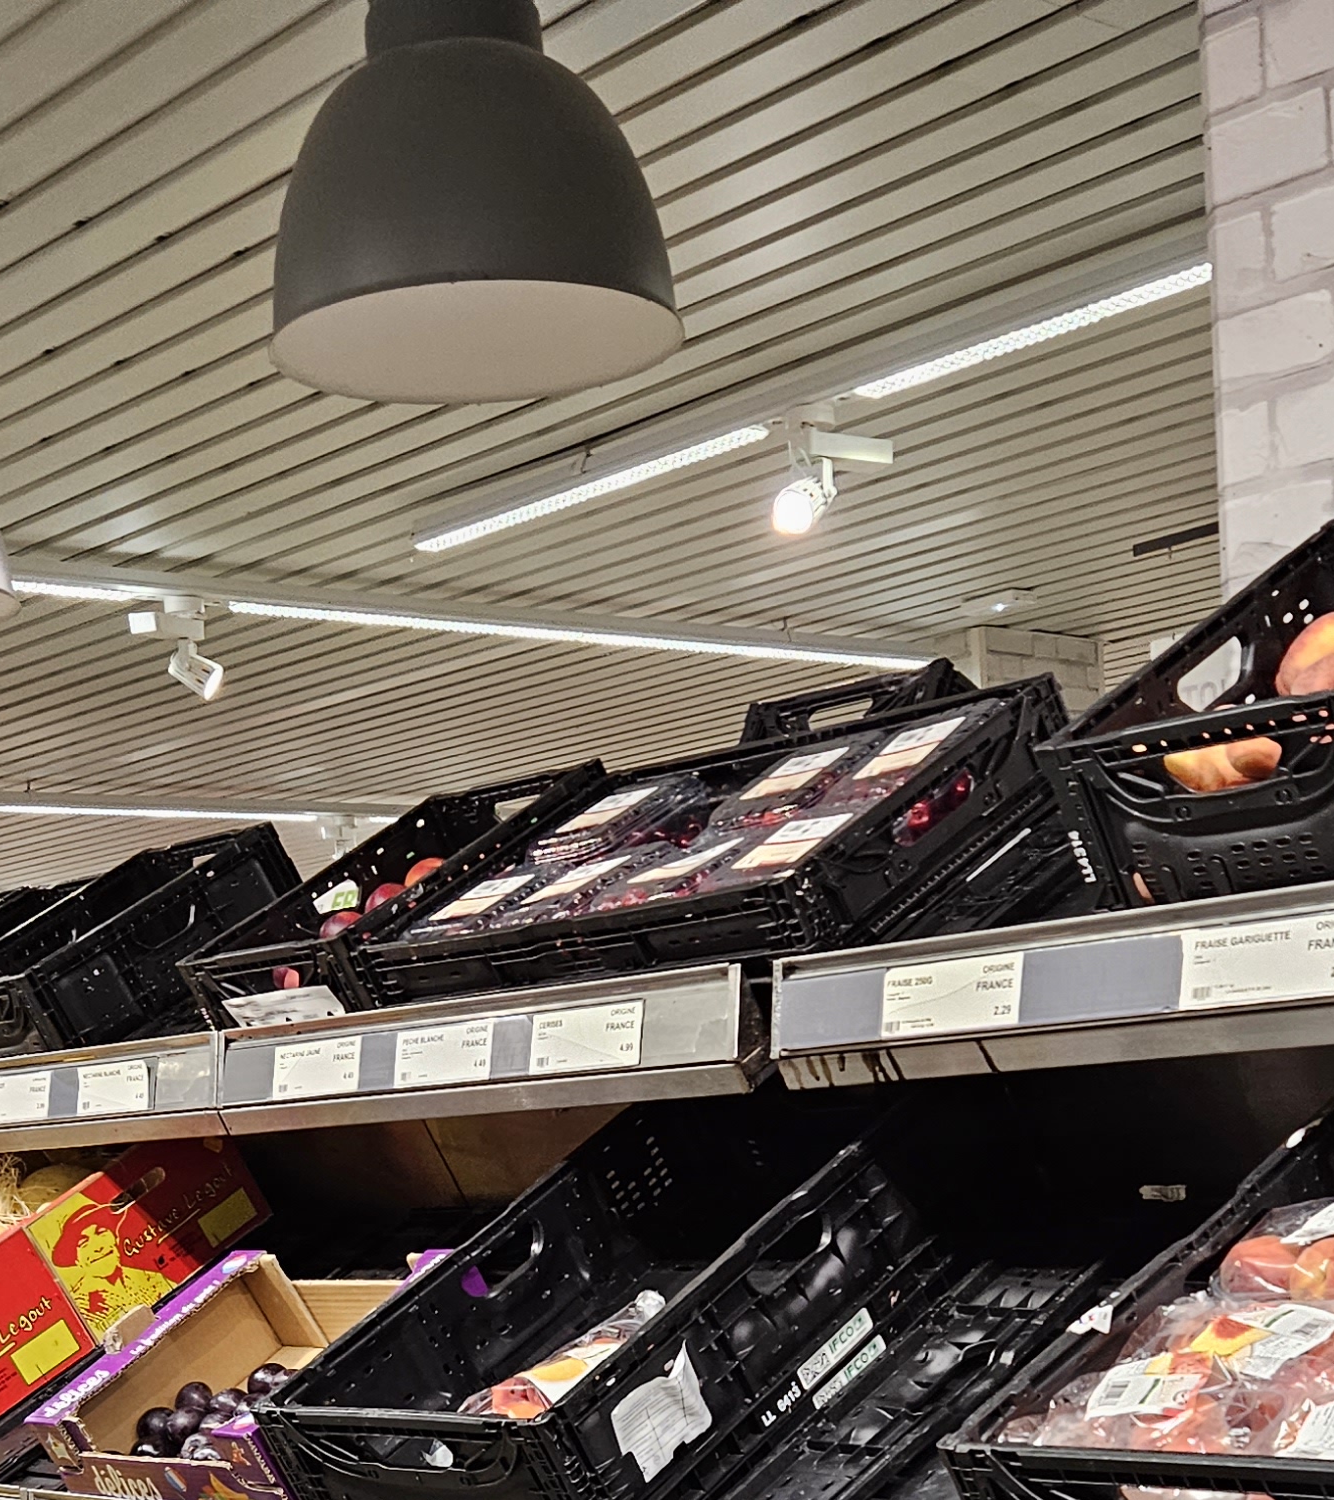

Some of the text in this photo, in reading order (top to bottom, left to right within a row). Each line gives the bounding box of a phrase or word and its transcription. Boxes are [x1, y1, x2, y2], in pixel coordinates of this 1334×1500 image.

[1194, 929, 1292, 951] FRAISE GARIGUETTE
[982, 961, 1016, 974] ORIGINE
[887, 979, 913, 988] FRAISE
[975, 977, 1014, 992] FRANCE
[609, 1006, 636, 1017] ORIGINE
[993, 1004, 1012, 1016] 2.29
[465, 1024, 489, 1035] ORIGINE
[605, 1019, 636, 1033] FRANCE
[336, 1040, 357, 1049] ORIGINE
[461, 1036, 489, 1050] FRANCE
[332, 1051, 356, 1063] FRANCE
[123, 1207, 180, 1257] Gustave
[827, 1325, 855, 1354] IFCO
[843, 1351, 869, 1381] IFCO
[760, 1410, 777, 1427] LL
